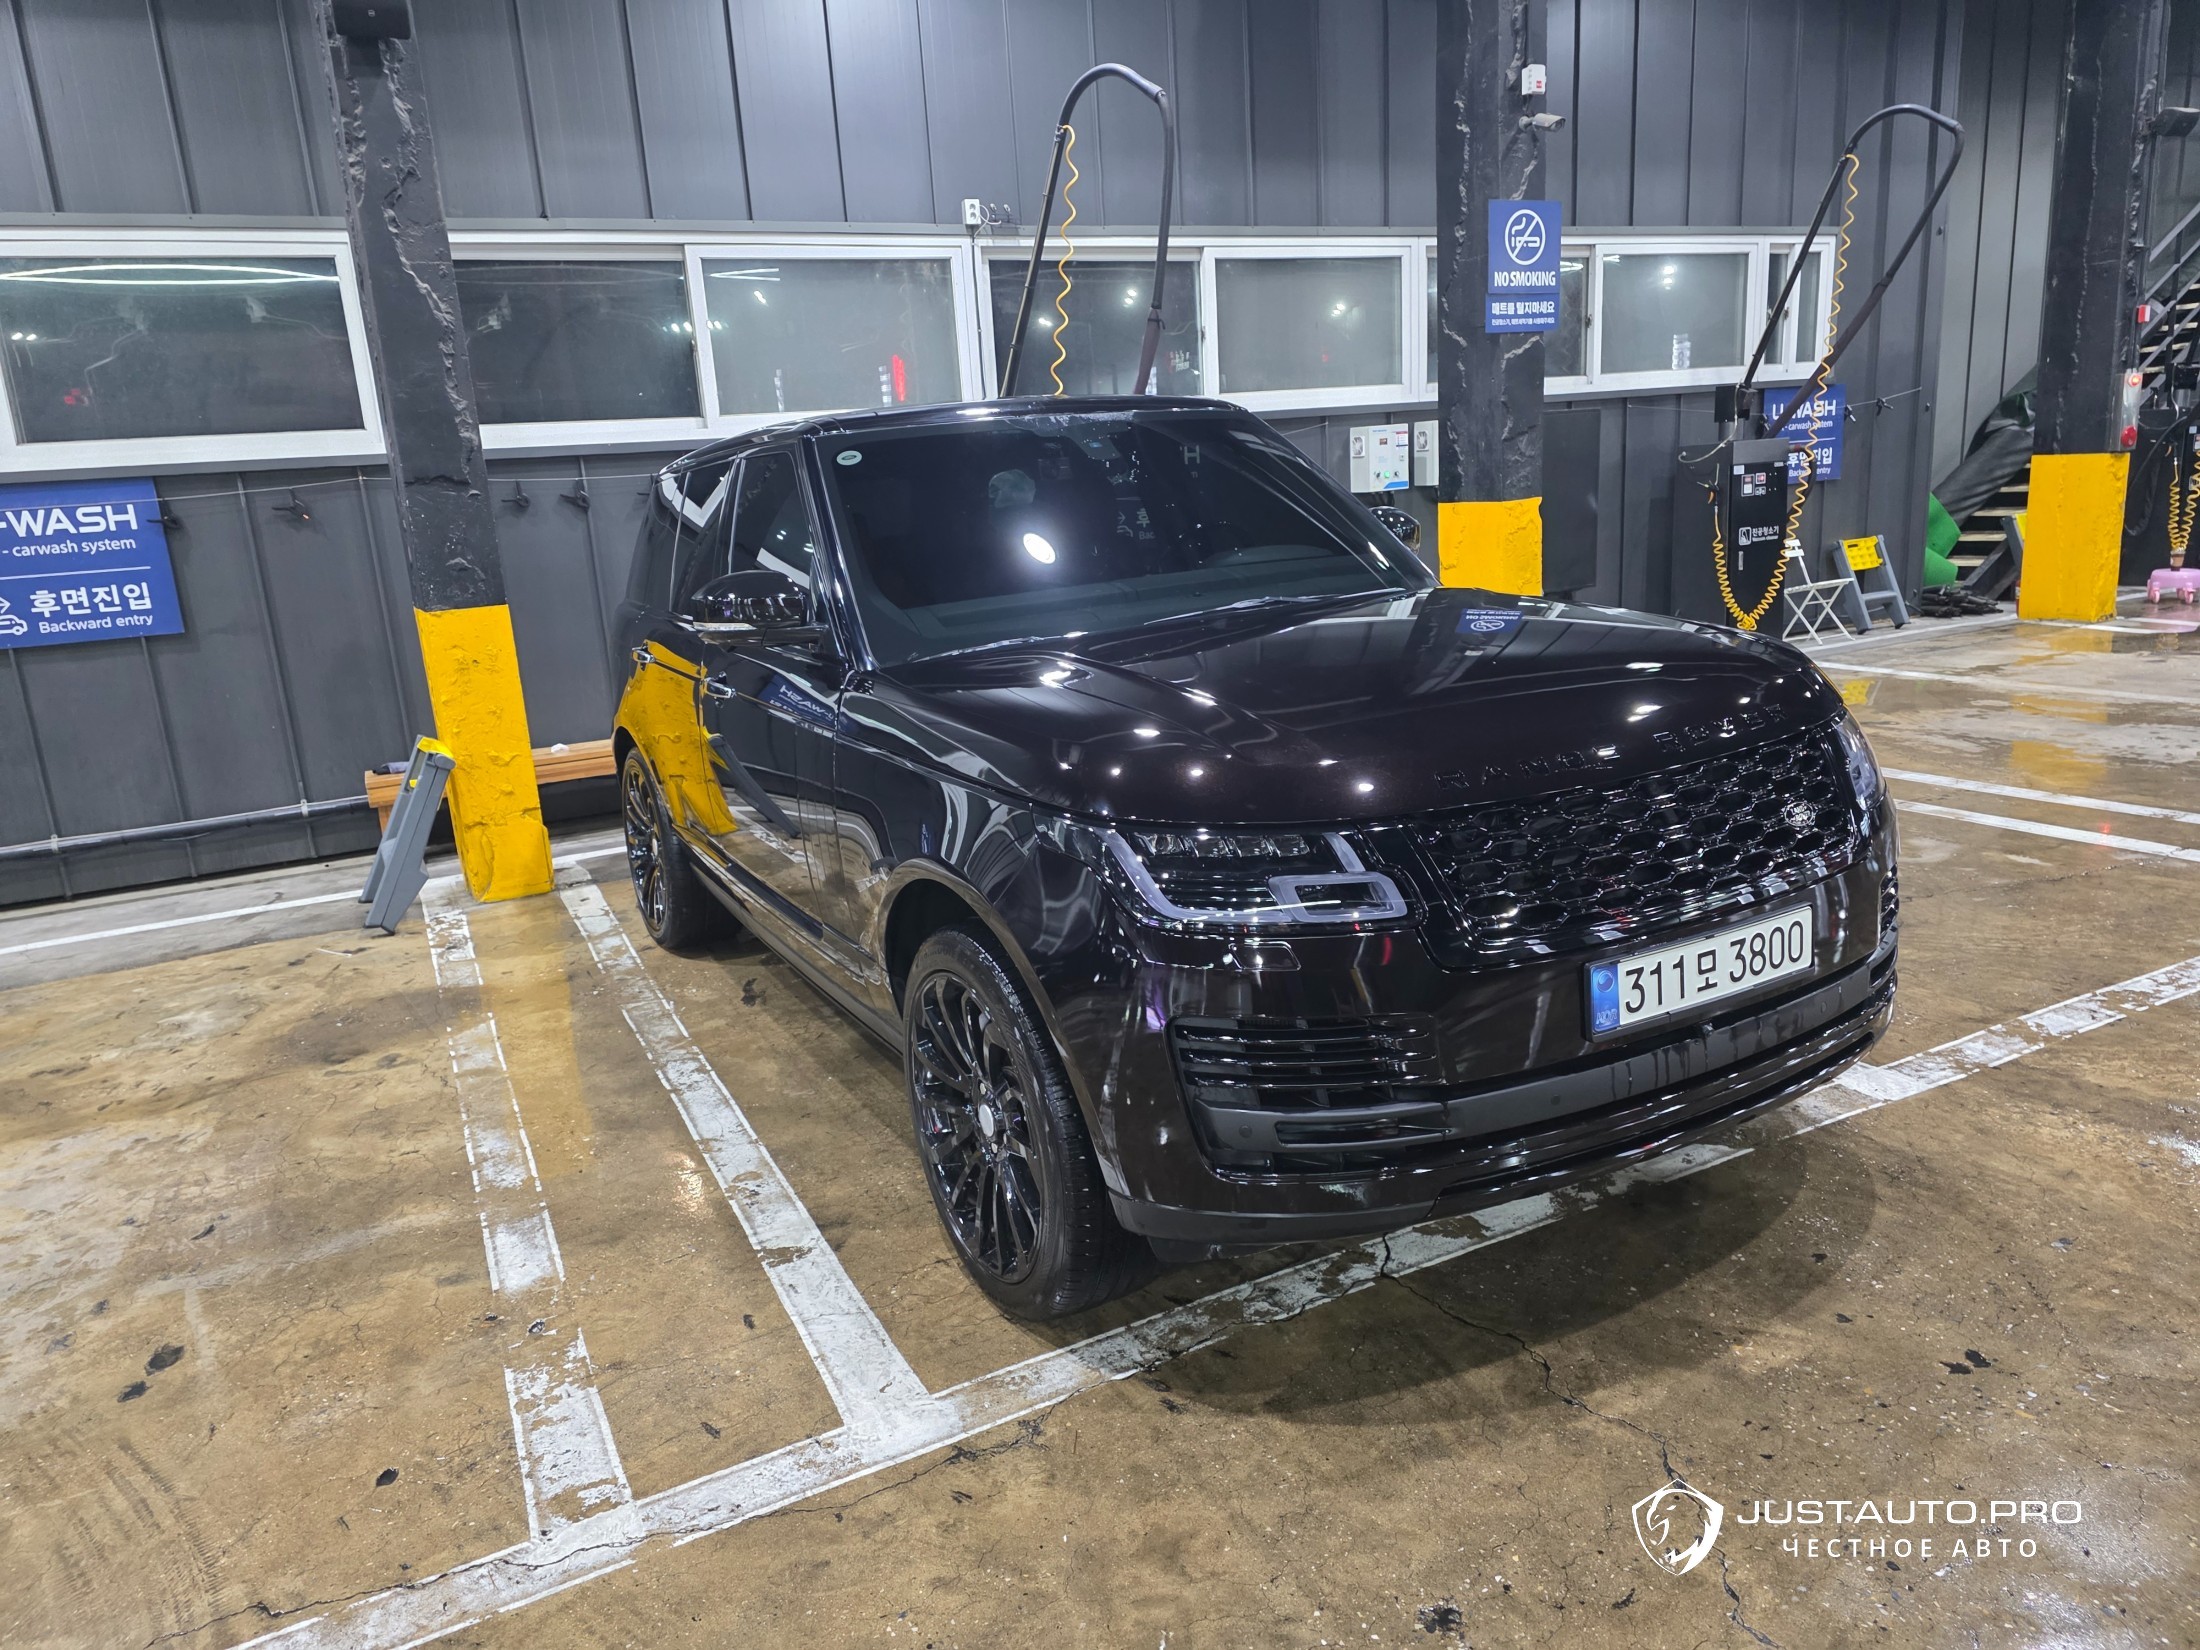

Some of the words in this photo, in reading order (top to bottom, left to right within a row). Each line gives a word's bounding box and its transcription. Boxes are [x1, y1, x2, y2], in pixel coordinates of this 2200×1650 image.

[1494, 271, 1509, 287] NO
[1510, 271, 1556, 287] SMOKING
[12, 540, 78, 557] carwash
[81, 538, 136, 555] system
[30, 582, 152, 618] 후면진입
[38, 616, 112, 634] Backward
[115, 614, 153, 627] entry
[1433, 744, 1620, 790] RANGE
[1652, 703, 1788, 753] ROVER
[1624, 948, 1718, 1014] 311모
[1729, 920, 1804, 984] 3800
